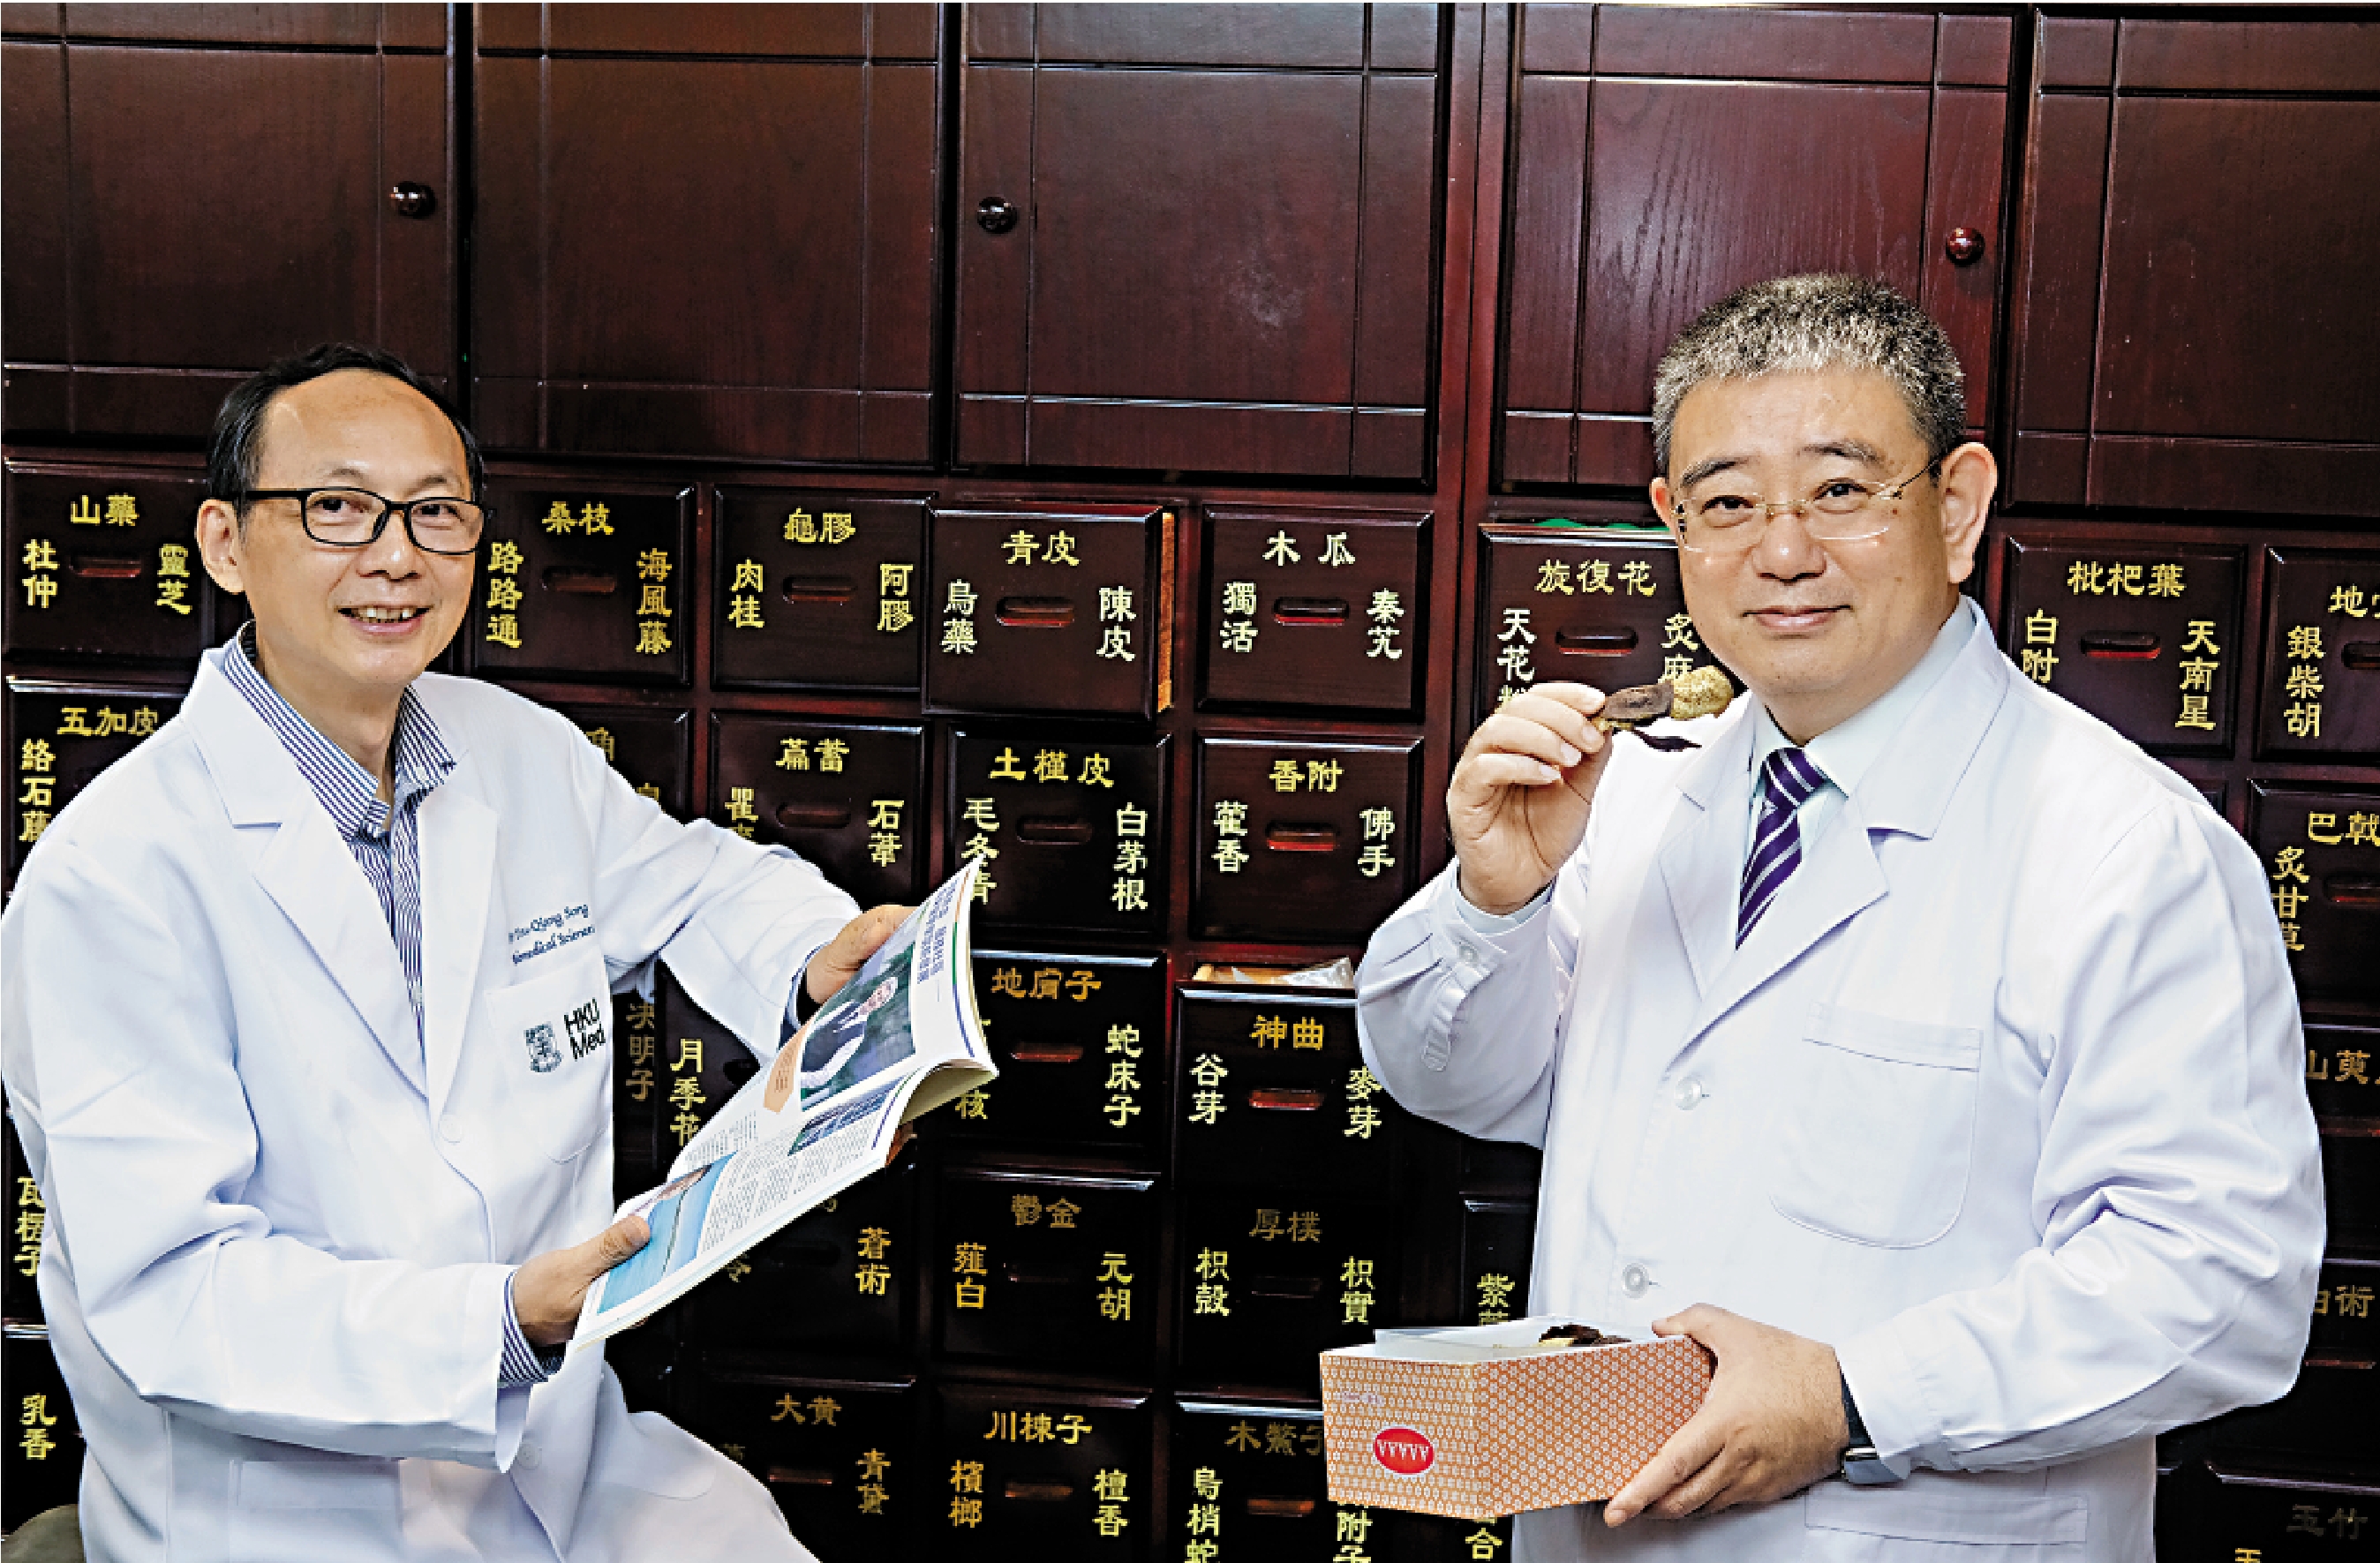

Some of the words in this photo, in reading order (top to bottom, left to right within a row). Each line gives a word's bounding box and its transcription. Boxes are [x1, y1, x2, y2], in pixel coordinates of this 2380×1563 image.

[70, 494, 140, 527] 山藥
[541, 500, 615, 536] 桑枝
[21, 538, 61, 609] 杜仲
[156, 543, 193, 615] 靈芝
[1001, 530, 1080, 567] 青皮
[1264, 531, 1356, 567] 木瓜
[2067, 560, 2185, 597] 枇杷葉
[486, 541, 524, 649] 路路通
[634, 547, 673, 655] 海風藤
[727, 559, 765, 628] 肉桂
[877, 563, 914, 633] 阿膠
[1096, 588, 1136, 662] 陳皮
[1219, 582, 1259, 652] 獨活
[2327, 585, 2380, 620] 地
[2020, 608, 2060, 684] 白附
[2174, 620, 2221, 731] 天南星
[2283, 625, 2325, 739] 銀柴胡
[56, 707, 158, 737] 五加皮
[990, 747, 1115, 788] 土槿皮
[1269, 757, 1345, 793] 香附
[960, 797, 1000, 904] 毛冬青
[1111, 801, 1149, 912] 白茅根
[1210, 800, 1249, 874] 藿香
[1358, 809, 1396, 876] 佛手
[563, 997, 600, 1035] HKU
[990, 967, 1102, 1003] 地膚子
[569, 1022, 606, 1061] Med
[1248, 1014, 1325, 1051] 神曲
[2306, 1049, 2380, 1085] 山萸
[669, 1038, 706, 1146] 月季花
[1103, 1023, 1144, 1126] 蛇床子
[1188, 1054, 1228, 1124] 谷芽
[1344, 1065, 1383, 1139] 麥芽
[1096, 1251, 1133, 1321] 元胡
[1195, 1246, 1230, 1317] 枳殼
[1339, 1255, 1376, 1323] 枳實
[19, 1393, 58, 1461] 乳香
[947, 1459, 984, 1529] 檳榔
[1091, 1468, 1131, 1537] 檀香
